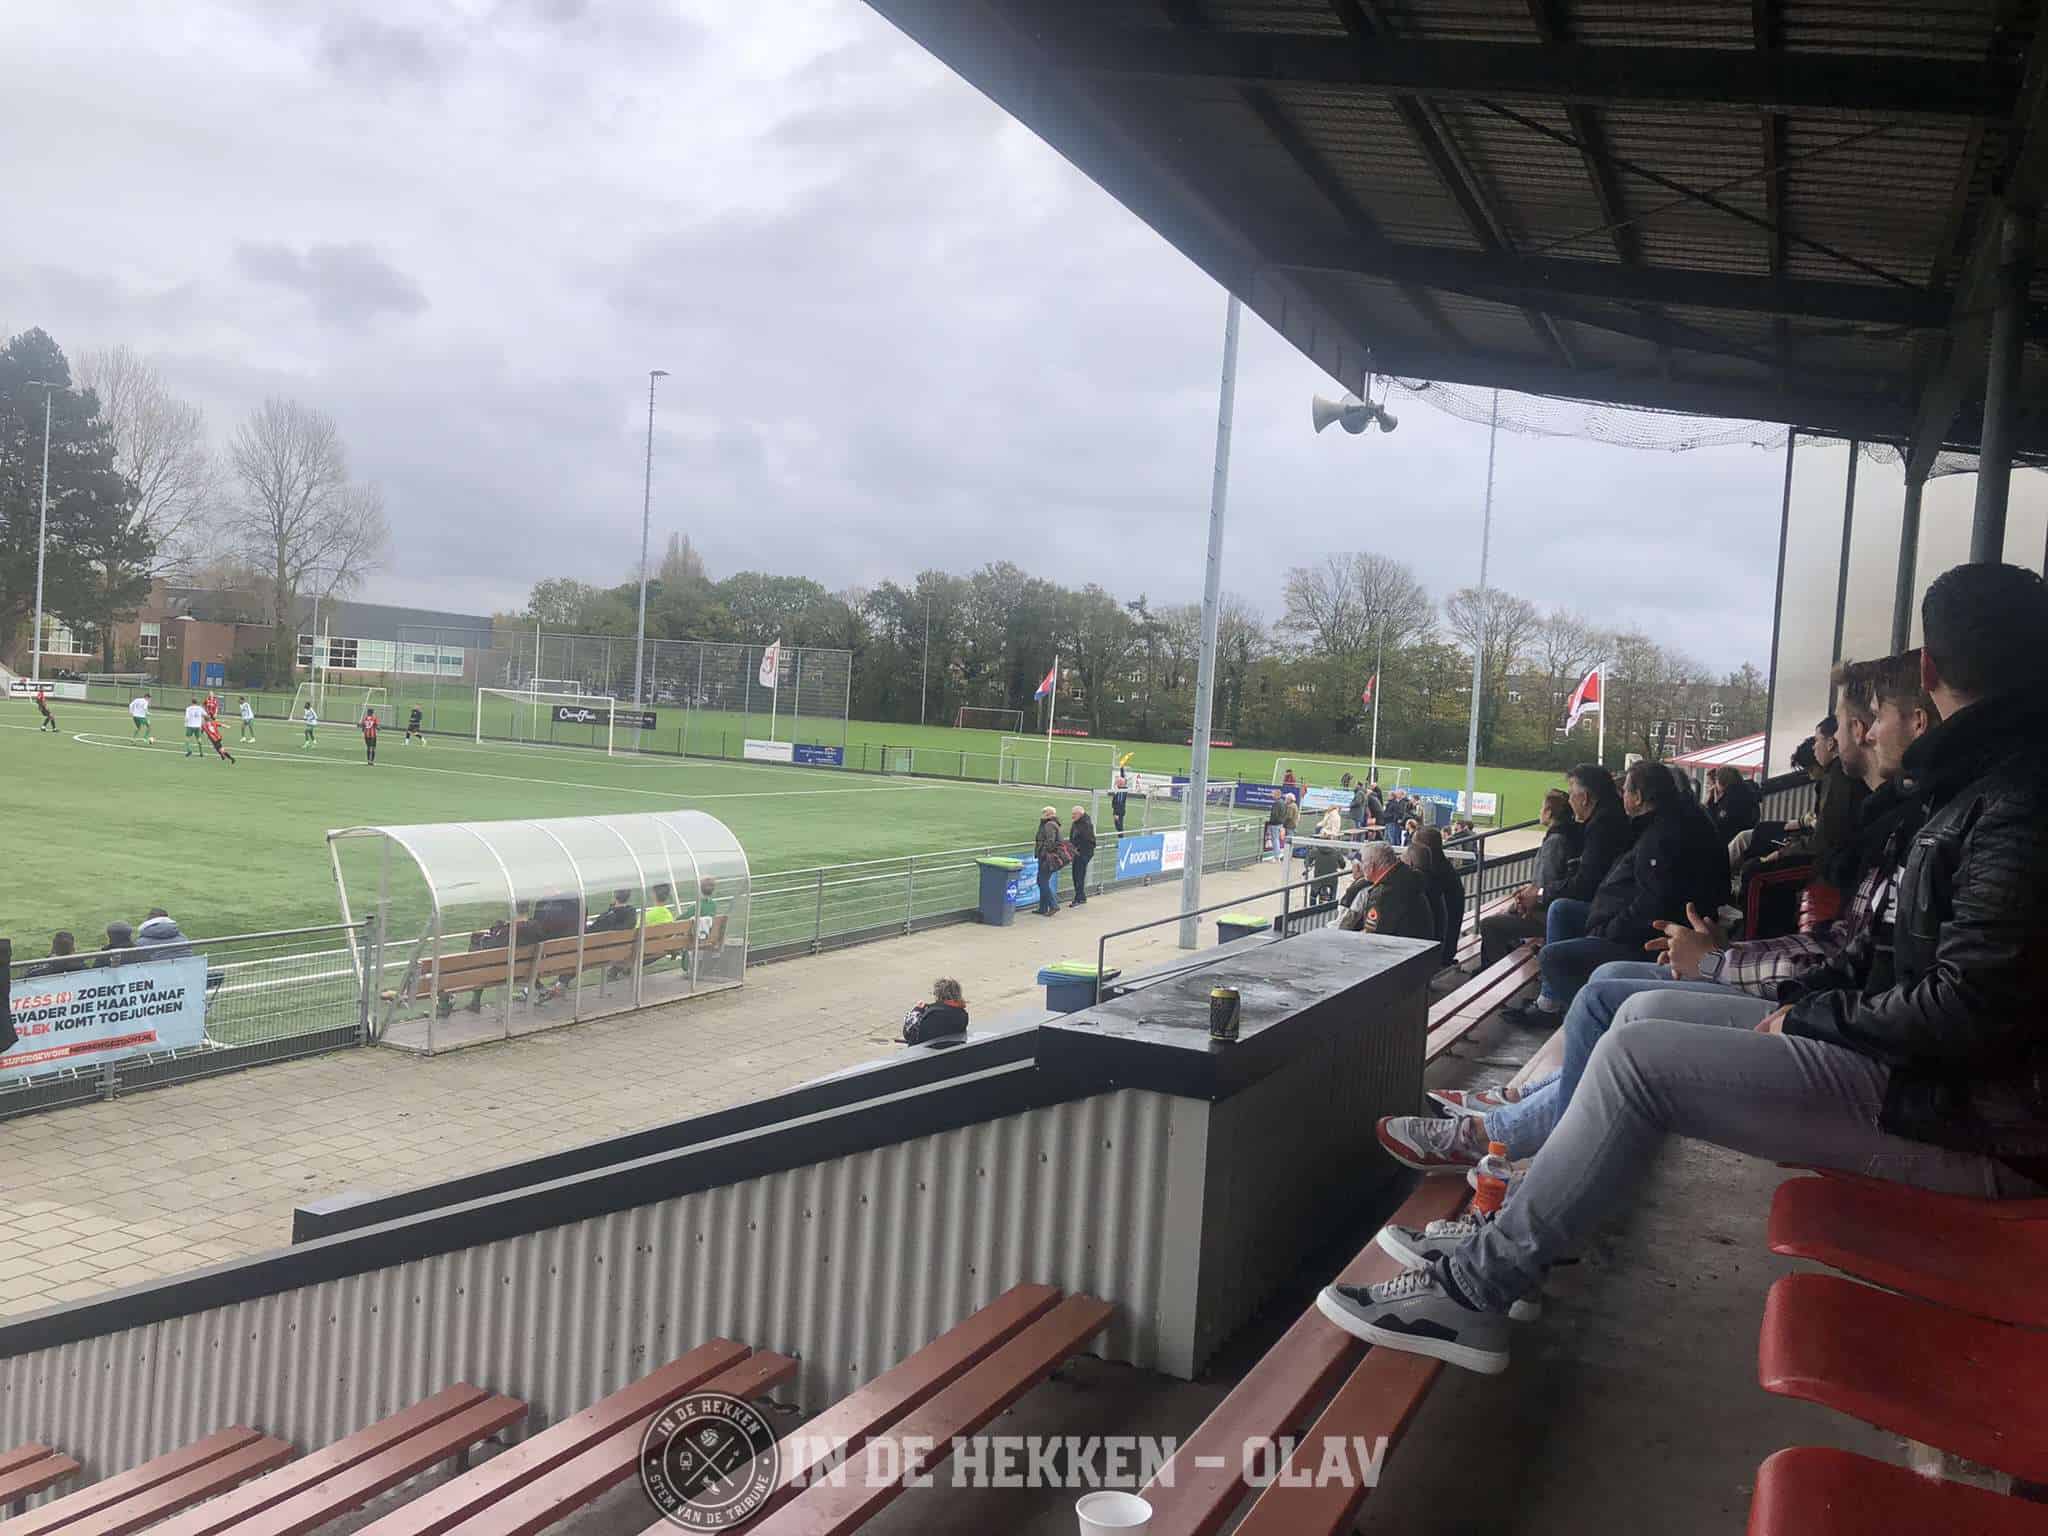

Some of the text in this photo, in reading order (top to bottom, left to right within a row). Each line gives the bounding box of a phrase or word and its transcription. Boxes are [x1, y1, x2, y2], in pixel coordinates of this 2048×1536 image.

[70, 1002, 94, 1016] DIE
[97, 996, 137, 1011] HAAR
[140, 988, 185, 1003] VANAF
[78, 984, 125, 1000] ZOEKT
[129, 979, 154, 992] EEN
[55, 1015, 96, 1031] KOMT
[99, 1001, 183, 1024] TOEJUICHEN
